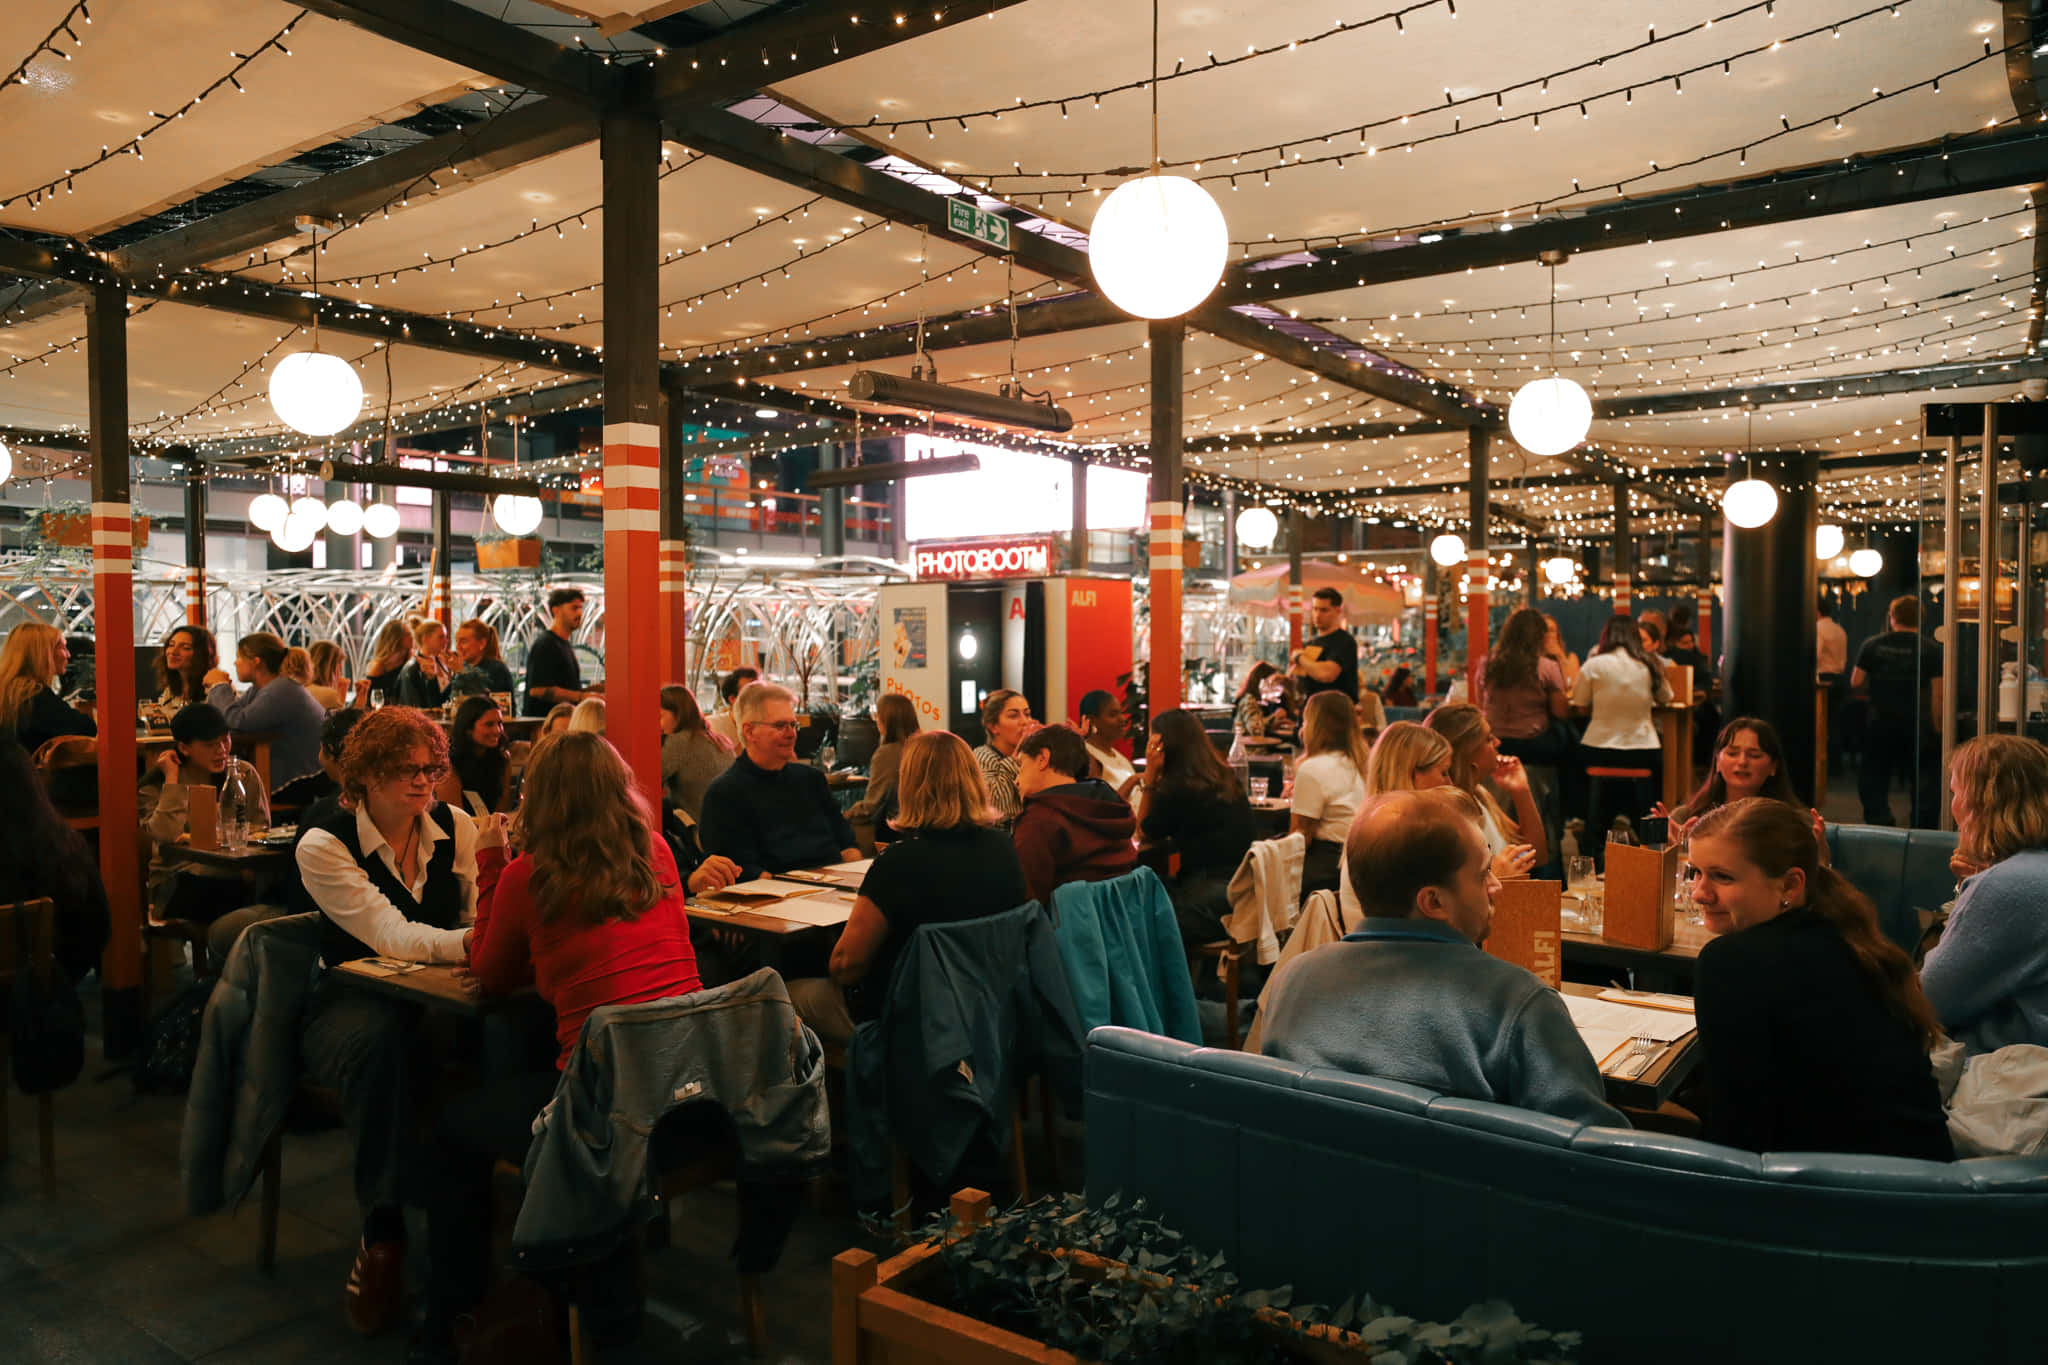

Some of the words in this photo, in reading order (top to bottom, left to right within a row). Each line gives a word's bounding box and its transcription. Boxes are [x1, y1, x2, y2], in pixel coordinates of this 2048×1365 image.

[953, 203, 969, 218] Fire
[918, 547, 1047, 575] PHOTOBOOTH
[1072, 590, 1097, 607] ALFI
[886, 677, 941, 721] PHOTOS
